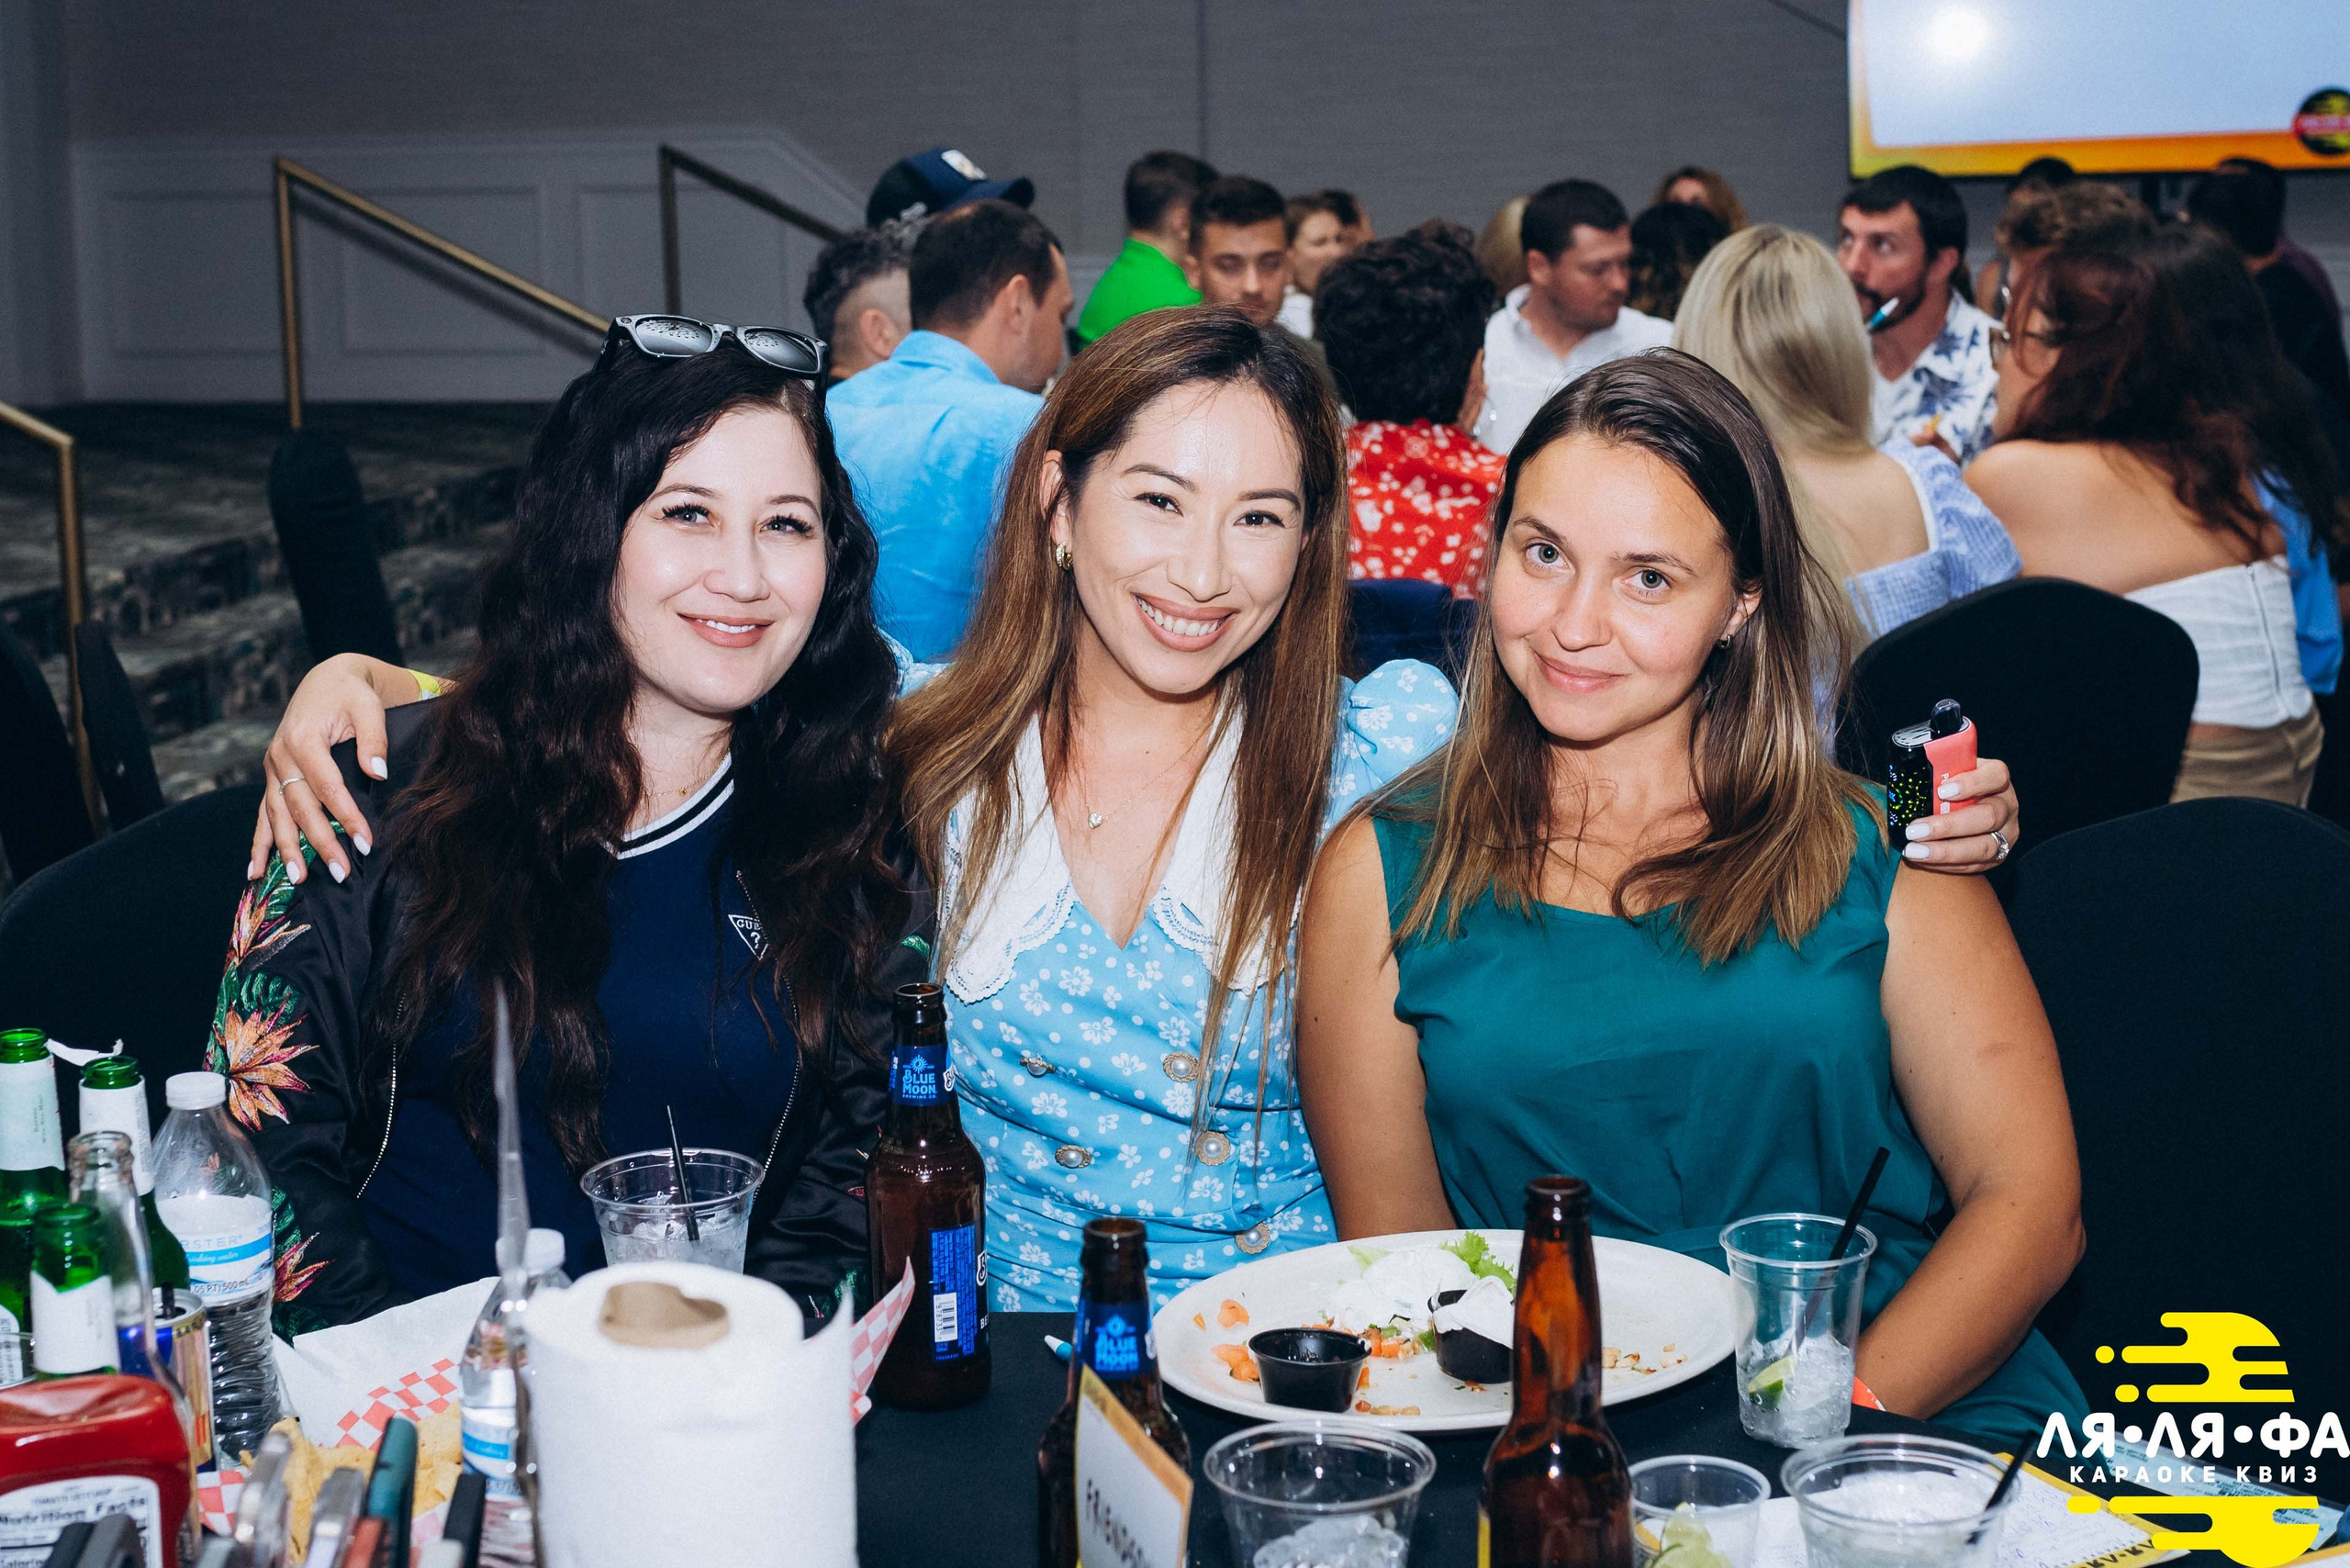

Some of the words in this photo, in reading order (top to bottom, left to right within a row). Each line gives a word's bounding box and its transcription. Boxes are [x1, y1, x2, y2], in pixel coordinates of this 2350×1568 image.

[736, 919, 761, 930] GUE
[902, 1070, 935, 1084] BLUE
[902, 1083, 936, 1094] MOON
[181, 1236, 240, 1249] RSTER
